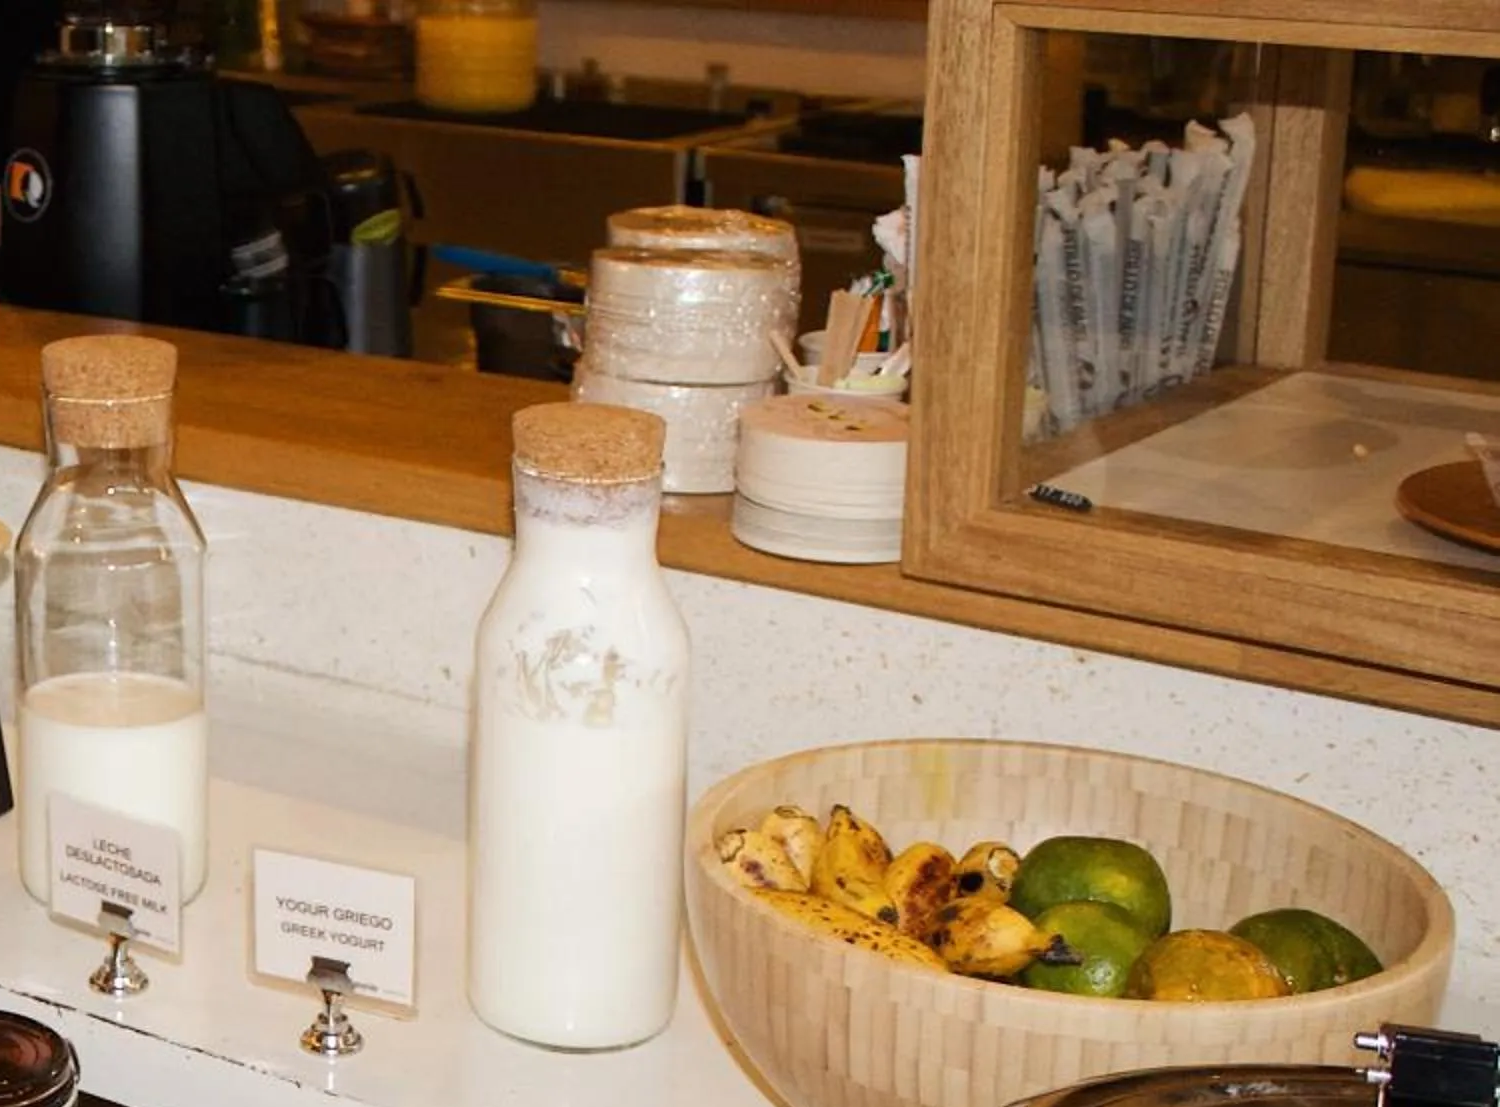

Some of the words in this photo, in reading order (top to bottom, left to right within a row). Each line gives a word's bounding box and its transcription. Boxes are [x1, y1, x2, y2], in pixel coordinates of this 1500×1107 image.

[65, 844, 162, 887] DESLACTOSADA
[93, 839, 132, 860] LECHE
[60, 869, 107, 895] LACTOSE
[111, 884, 140, 906] FREE
[142, 897, 168, 914] MILK
[275, 895, 329, 919] YOGUR
[333, 907, 393, 931] GRIEGO
[280, 921, 326, 942] GREEK
[330, 931, 385, 953] YOGURT
